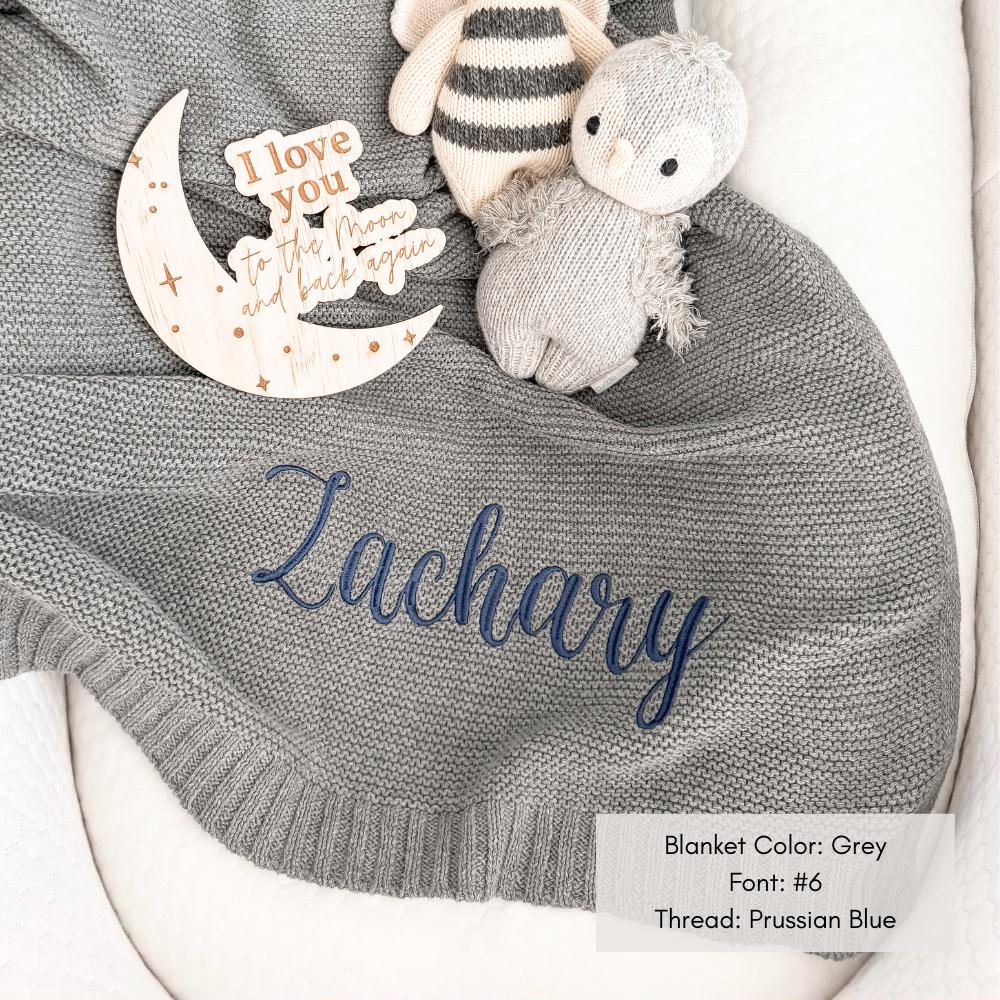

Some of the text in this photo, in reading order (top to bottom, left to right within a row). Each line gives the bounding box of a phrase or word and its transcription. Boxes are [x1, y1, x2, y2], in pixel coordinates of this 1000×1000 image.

[237, 131, 352, 184] I love
[271, 170, 349, 224] you
[240, 248, 272, 286] to
[276, 225, 324, 273] the
[241, 237, 436, 317] and back again
[251, 464, 730, 730] Zachary
